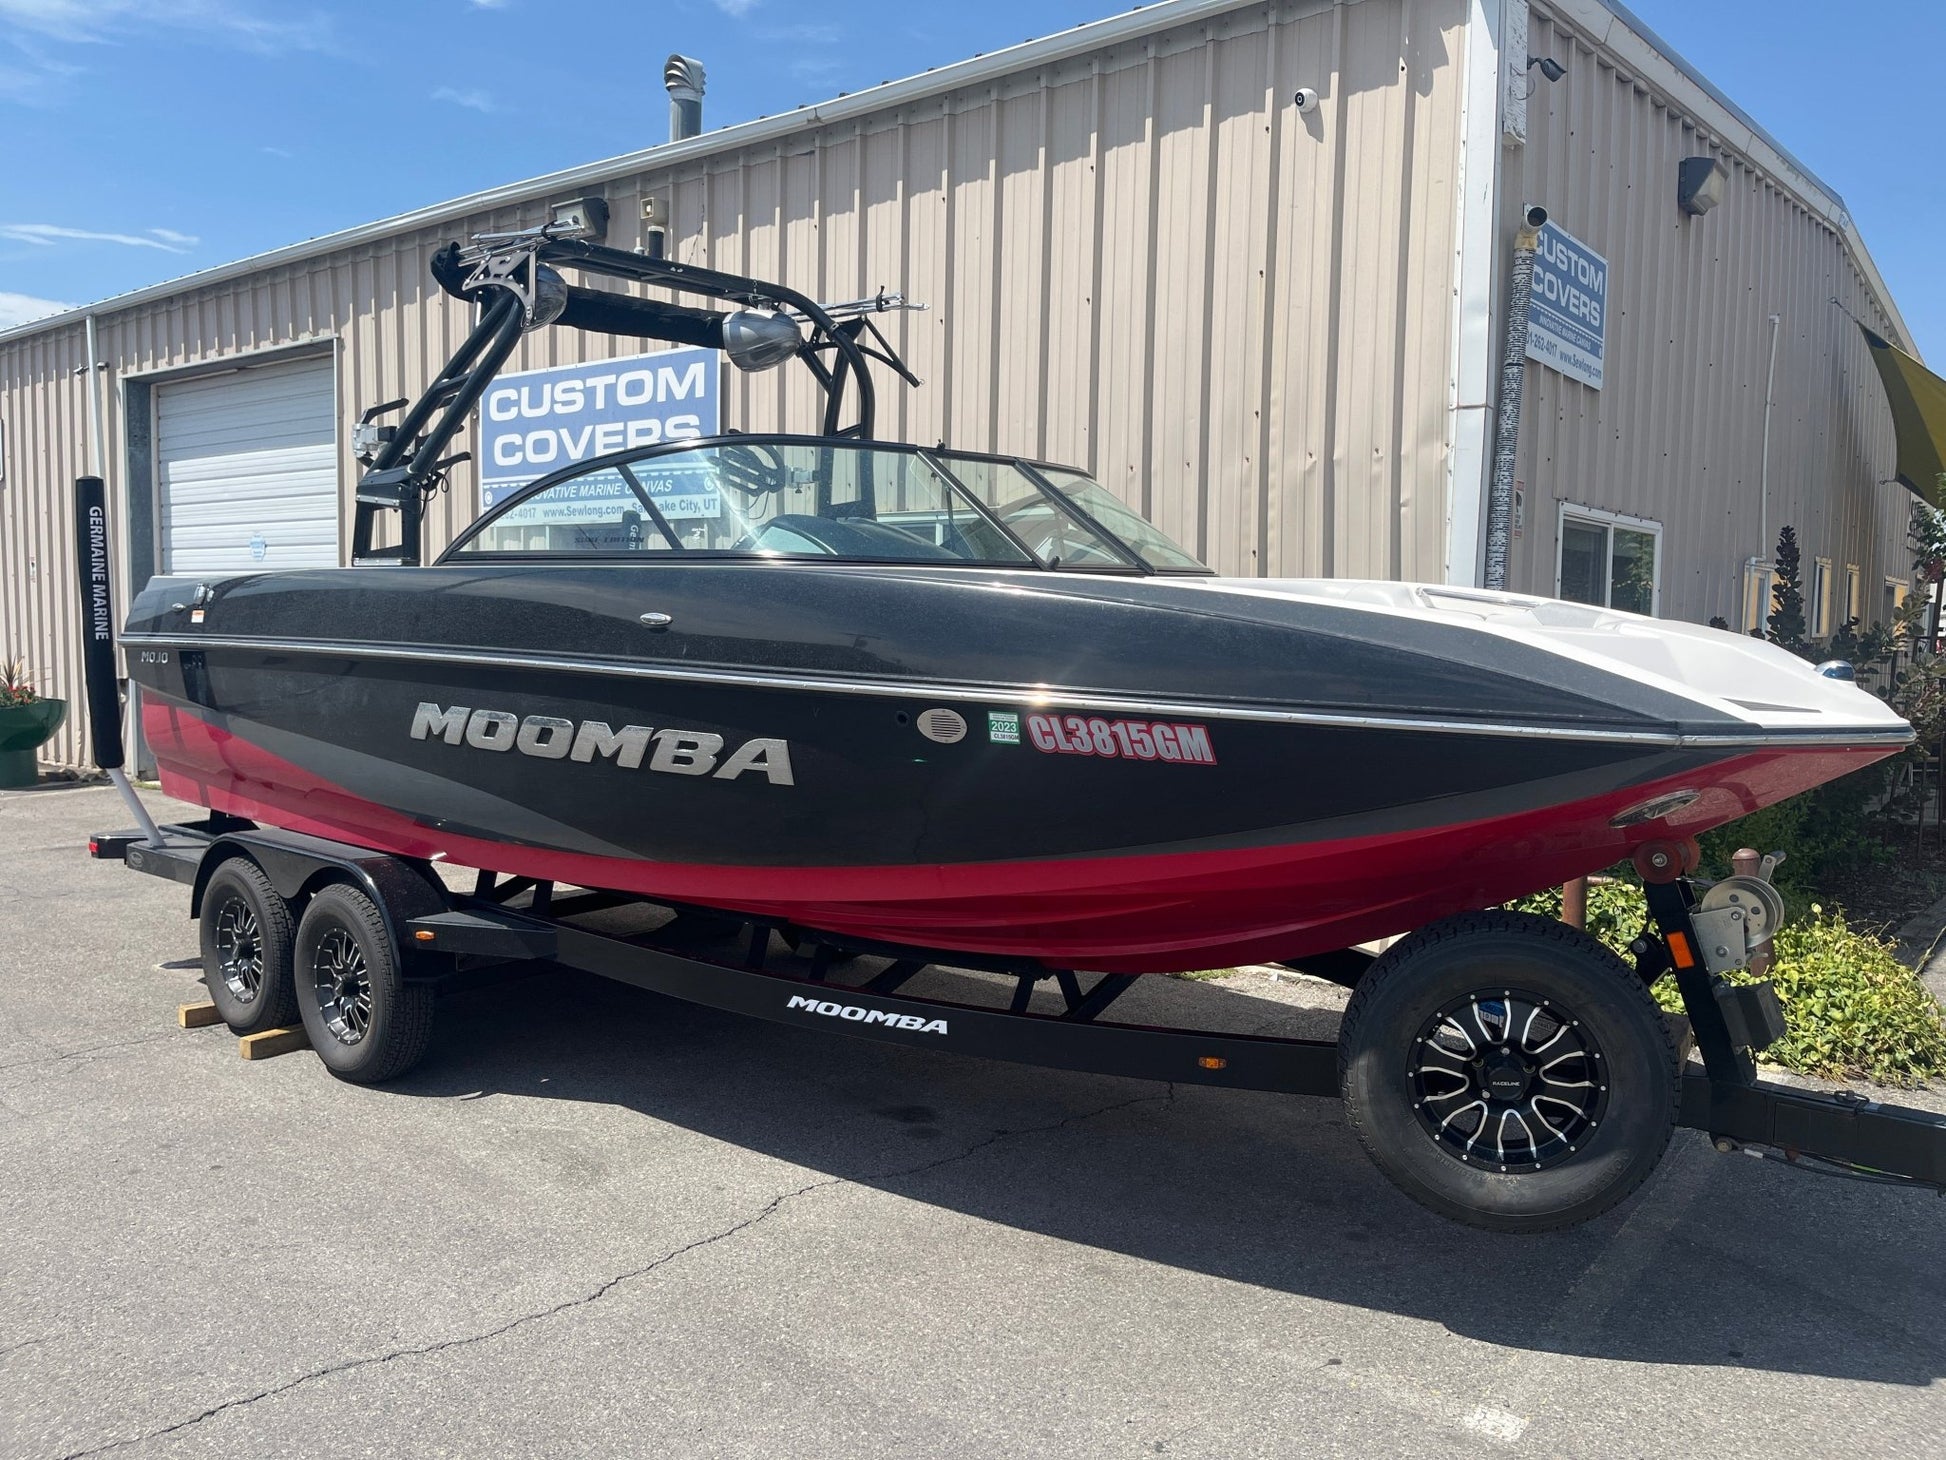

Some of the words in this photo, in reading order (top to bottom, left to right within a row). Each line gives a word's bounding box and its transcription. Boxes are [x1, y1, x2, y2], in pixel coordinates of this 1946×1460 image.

[1536, 230, 1604, 296] CUSTOM
[1532, 264, 1600, 327] COVERS
[489, 362, 705, 422] CUSTOM
[494, 414, 702, 467] COVERS
[543, 504, 624, 519] www.Sewlong.com
[660, 500, 676, 512] ake
[679, 499, 701, 513] City,
[704, 498, 718, 510] UT
[579, 482, 622, 497] MARINE
[625, 479, 673, 495] CNVAS
[89, 506, 106, 581] GERMAINE
[93, 584, 109, 641] MARINE
[141, 651, 169, 663] MOJO
[410, 702, 795, 786] MOOMBA
[991, 721, 1017, 732] 2023
[1027, 714, 1216, 764] CL3815GM
[787, 995, 949, 1035] MOOMBA
